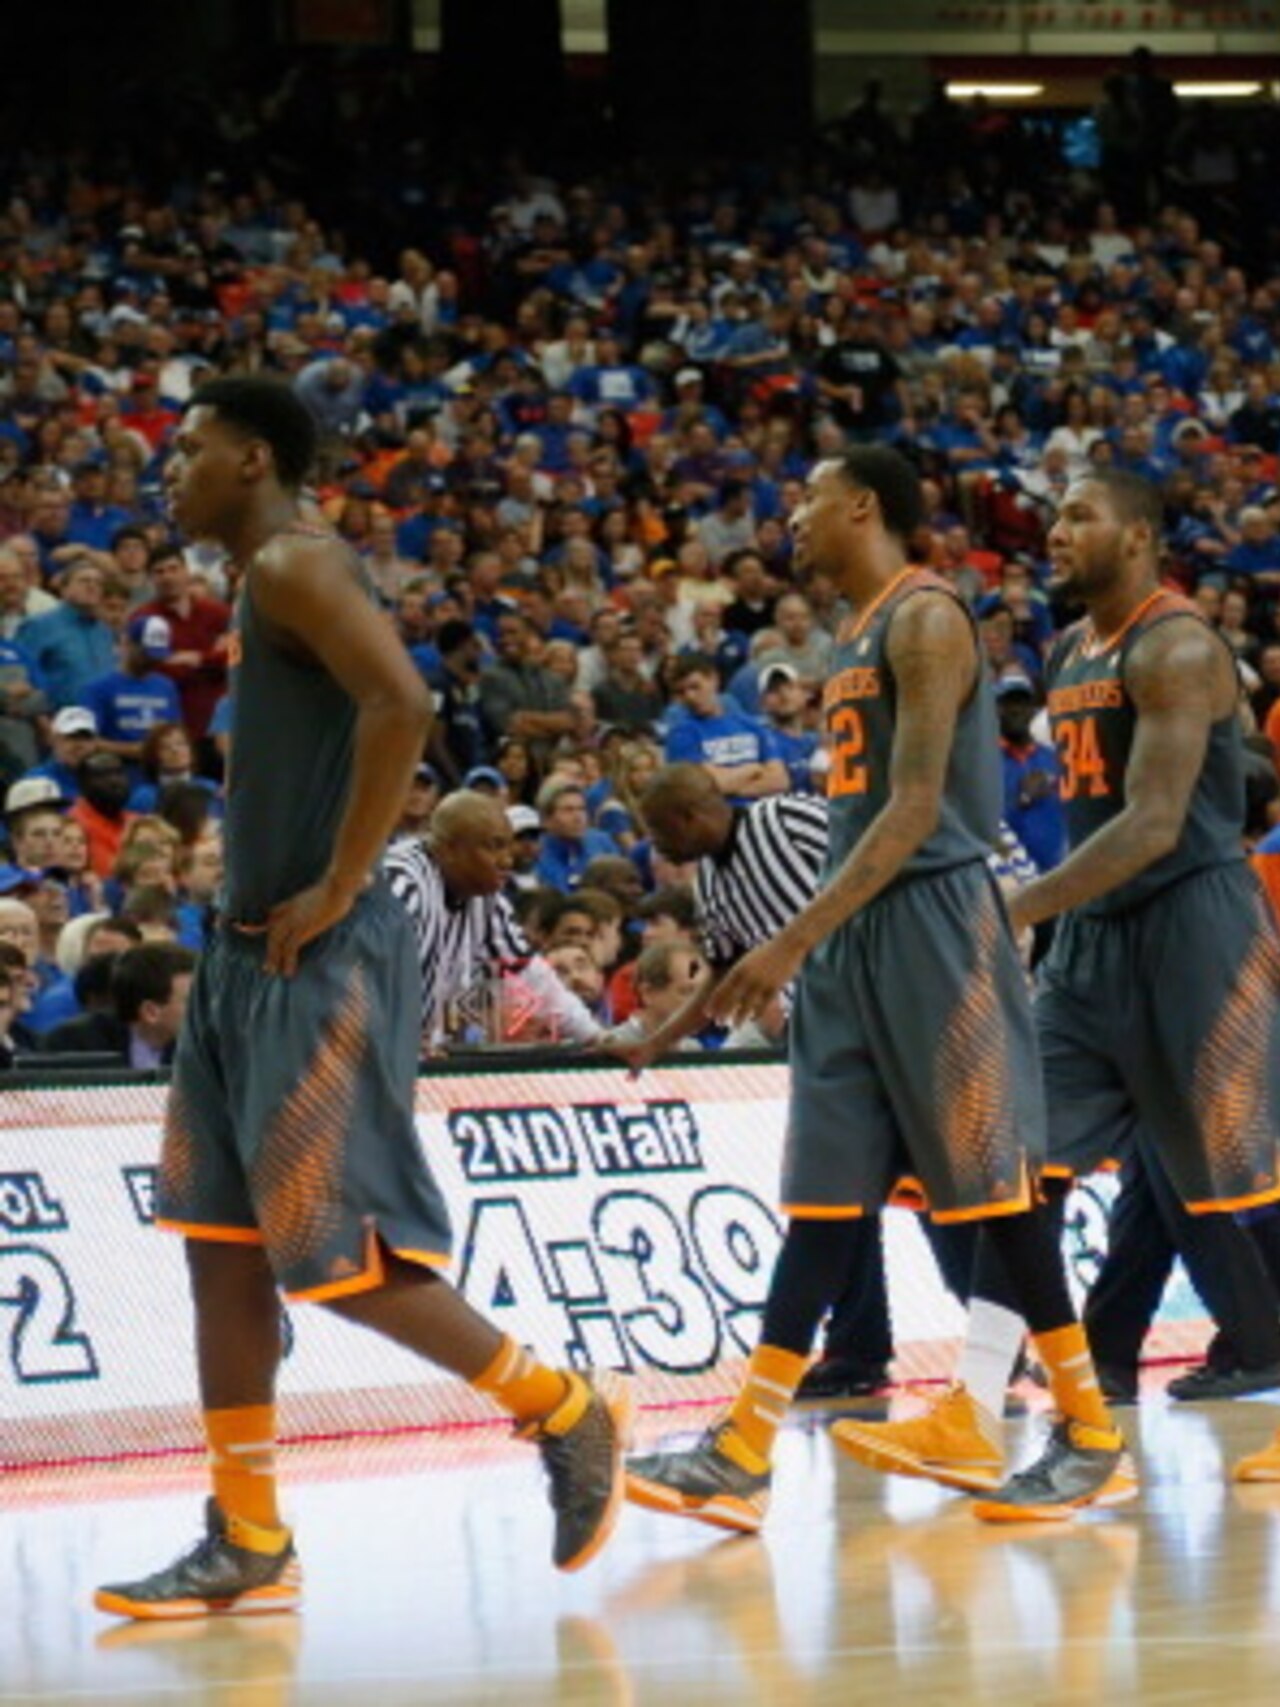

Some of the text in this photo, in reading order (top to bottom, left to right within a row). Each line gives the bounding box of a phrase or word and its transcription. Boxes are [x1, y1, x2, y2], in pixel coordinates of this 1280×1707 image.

[1052, 716, 1110, 799] 34
[448, 1099, 705, 1181] 2ND Half
[457, 1184, 788, 1376] 4:39
